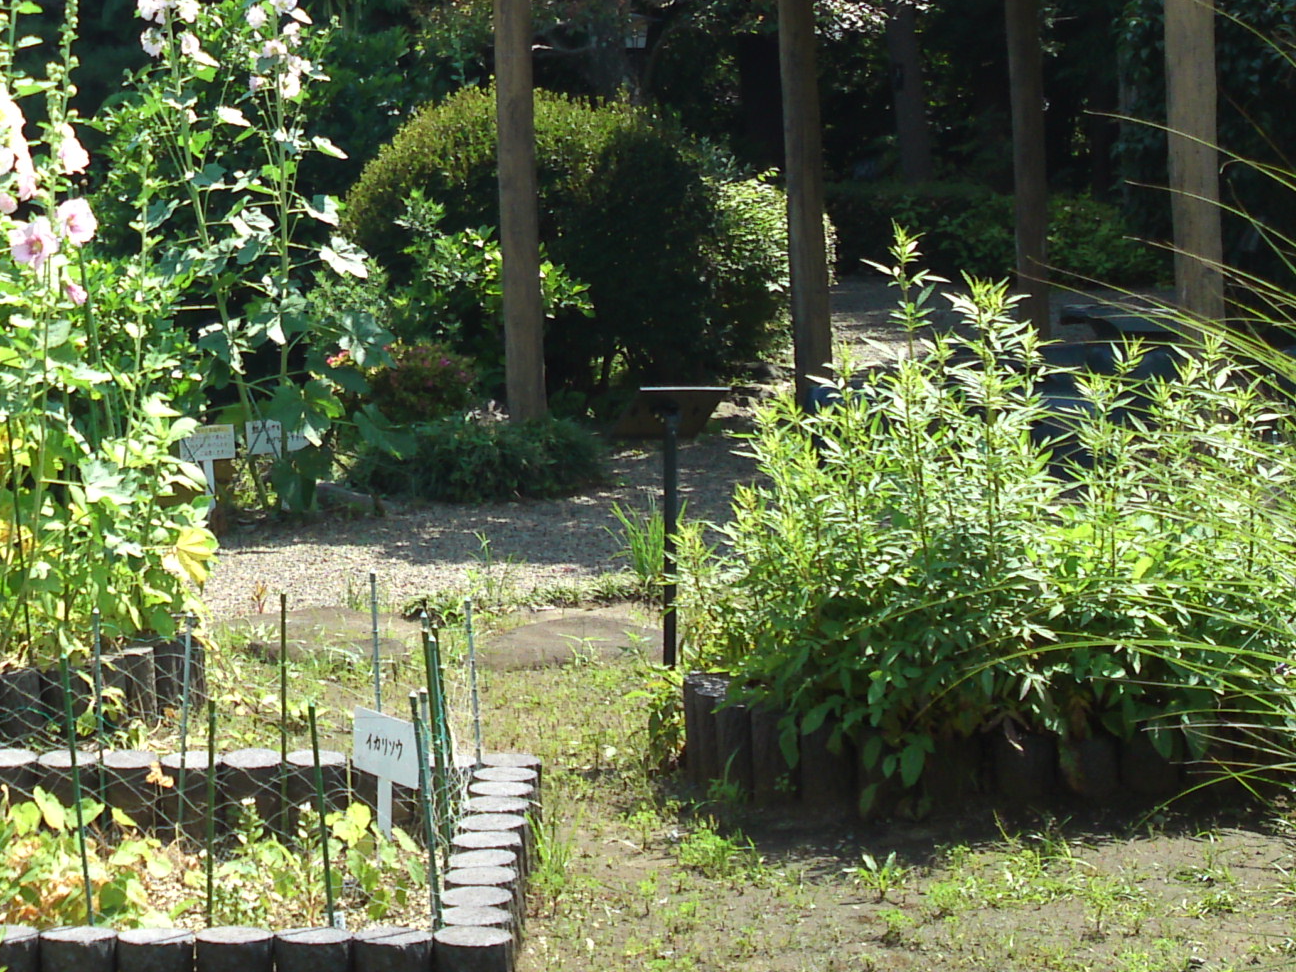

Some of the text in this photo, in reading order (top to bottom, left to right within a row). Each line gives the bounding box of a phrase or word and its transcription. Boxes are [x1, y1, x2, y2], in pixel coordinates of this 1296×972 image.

[365, 733, 403, 761] イカリソウ
